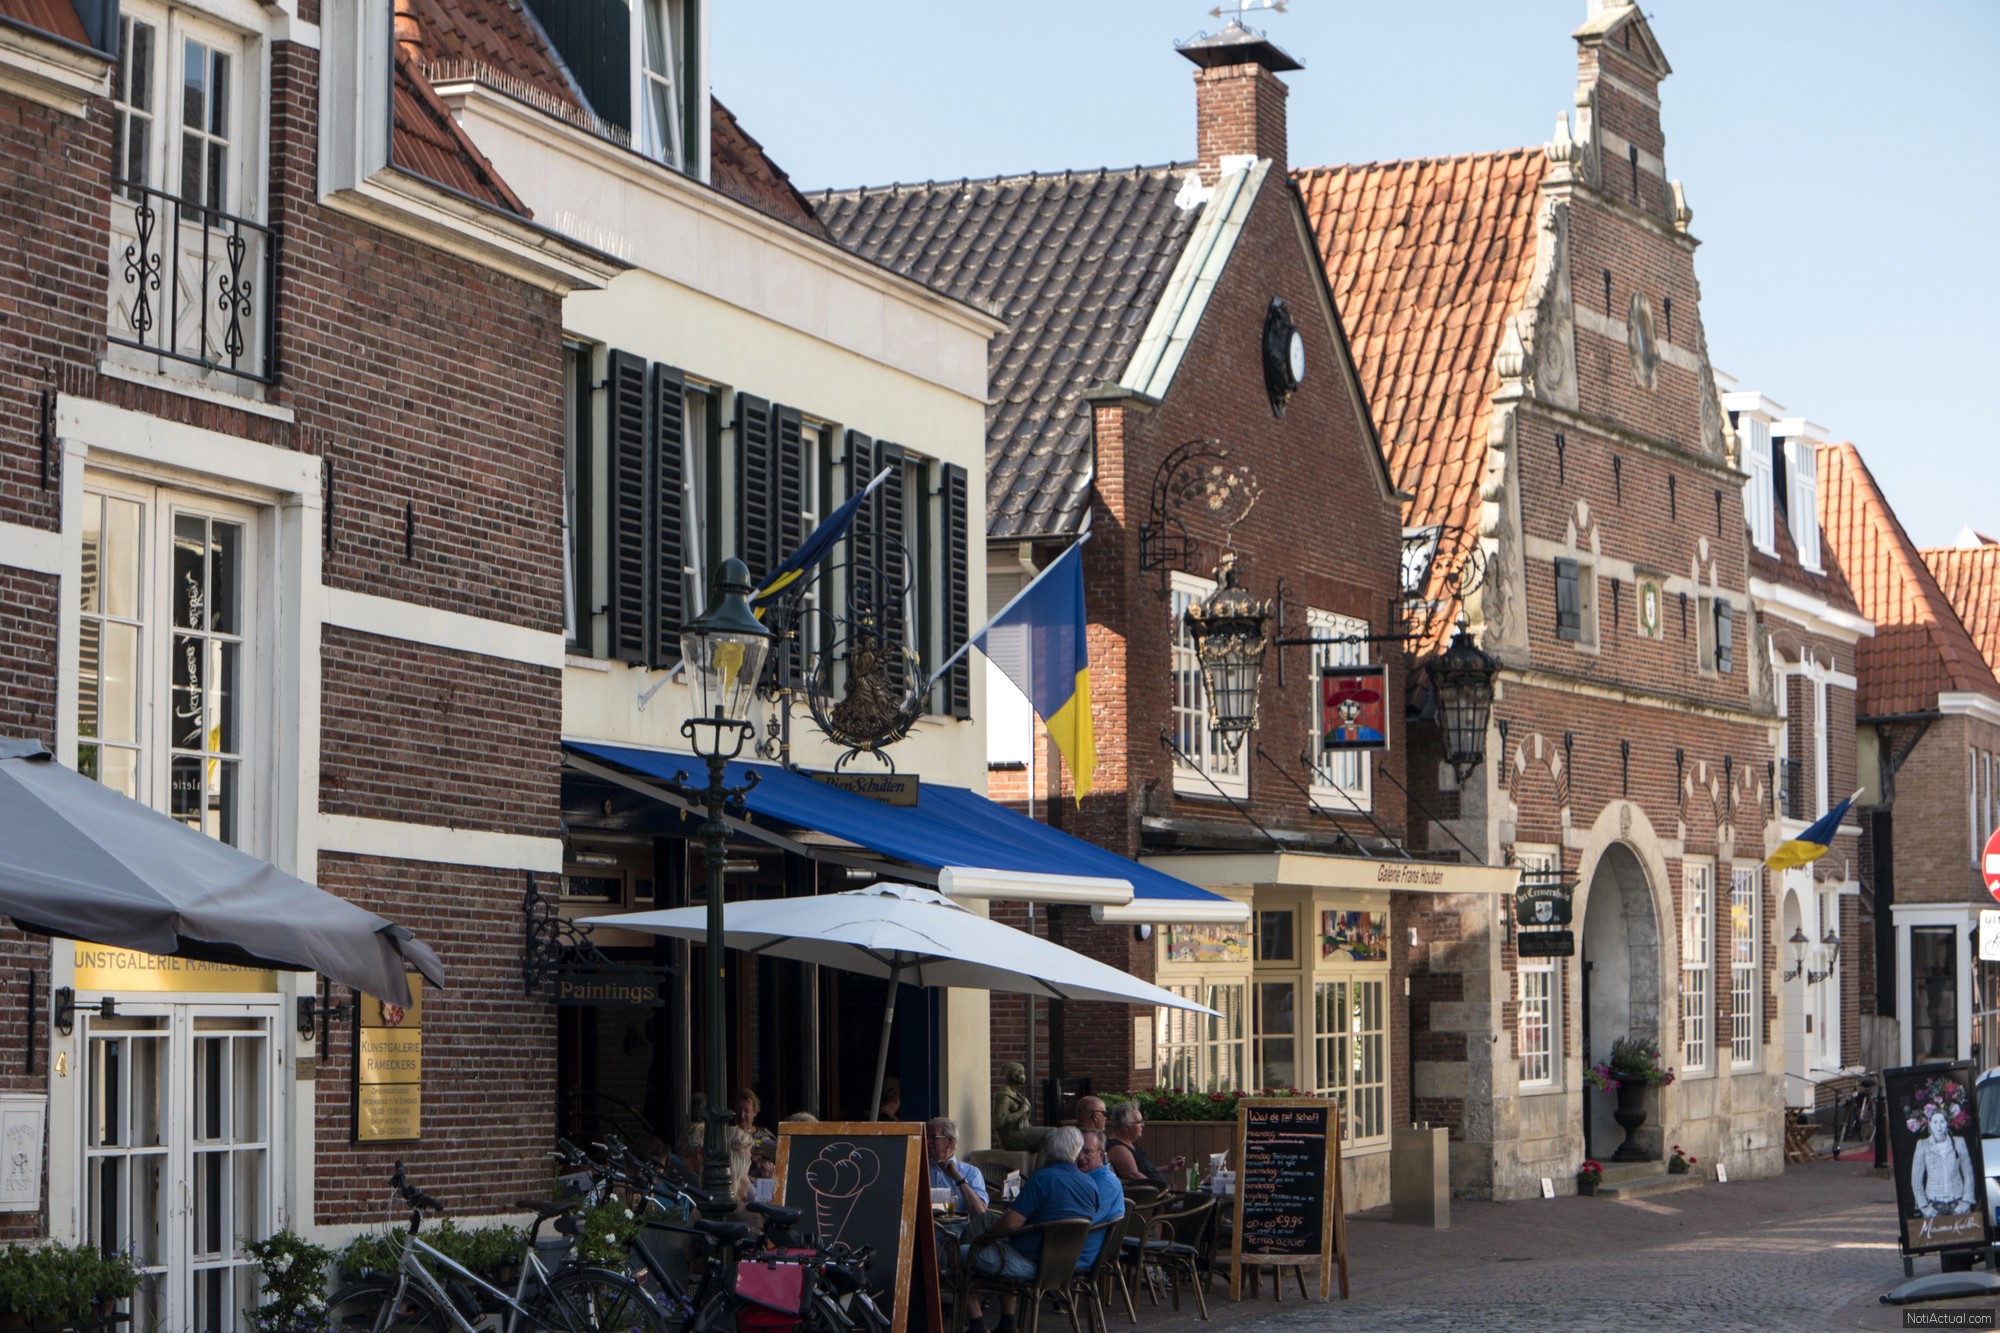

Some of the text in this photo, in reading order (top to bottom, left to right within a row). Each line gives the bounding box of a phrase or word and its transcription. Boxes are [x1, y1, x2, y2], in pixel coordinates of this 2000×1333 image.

[1377, 863, 1444, 885] Galerie Frans Houben
[74, 951, 181, 971] UNSTGALERIE
[559, 981, 655, 1004] Paintings
[361, 1040, 420, 1053] KUNSTGALERIE
[54, 1050, 68, 1077] 4
[367, 1058, 416, 1070] RAMECKERS
[1248, 1235, 1274, 1244] Terras
